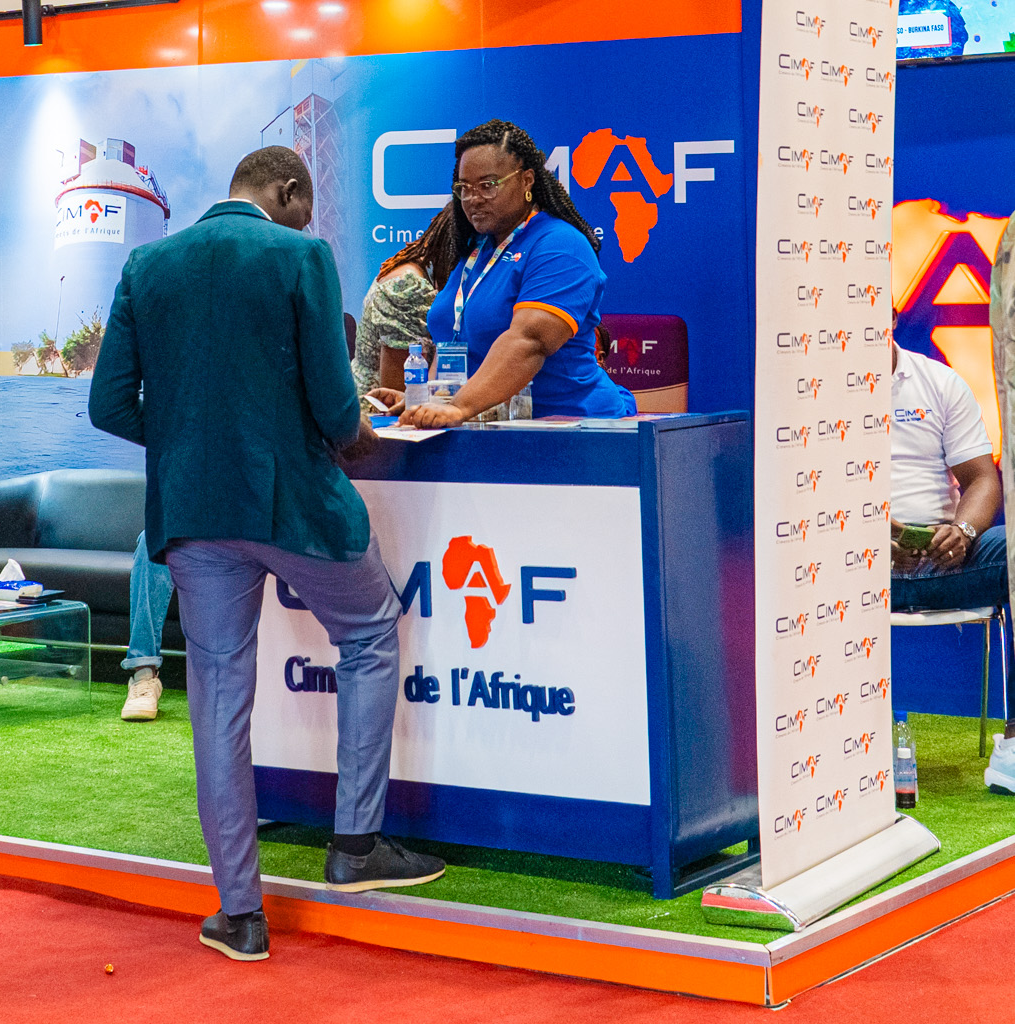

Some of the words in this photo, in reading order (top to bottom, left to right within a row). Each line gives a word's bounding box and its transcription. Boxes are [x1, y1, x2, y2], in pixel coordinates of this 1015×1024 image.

[797, 10, 826, 29] CIMAF
[797, 101, 825, 117] CIMAF
[849, 108, 883, 124] CIMAF
[820, 149, 853, 165] CIMAF
[848, 195, 883, 211] CIMAF
[798, 285, 823, 301] CIMAF
[847, 283, 882, 298] CIMAF
[621, 367, 661, 376] l'Afrique
[847, 372, 881, 387] CIMAF
[797, 378, 823, 394] CIMAF
[895, 409, 932, 417] CIMAF
[846, 461, 880, 476] CIMAF
[817, 510, 851, 527] CIMAF
[776, 519, 810, 538] CIMAF
[795, 562, 821, 582] CIMAF
[793, 655, 821, 677] CIMAF
[404, 665, 441, 704] de
[451, 666, 576, 722] l'Afrique
[816, 692, 849, 715] CIMAF
[775, 708, 808, 732] CIMAF
[843, 731, 876, 754] CIMAF
[791, 754, 821, 779] CIMAF
